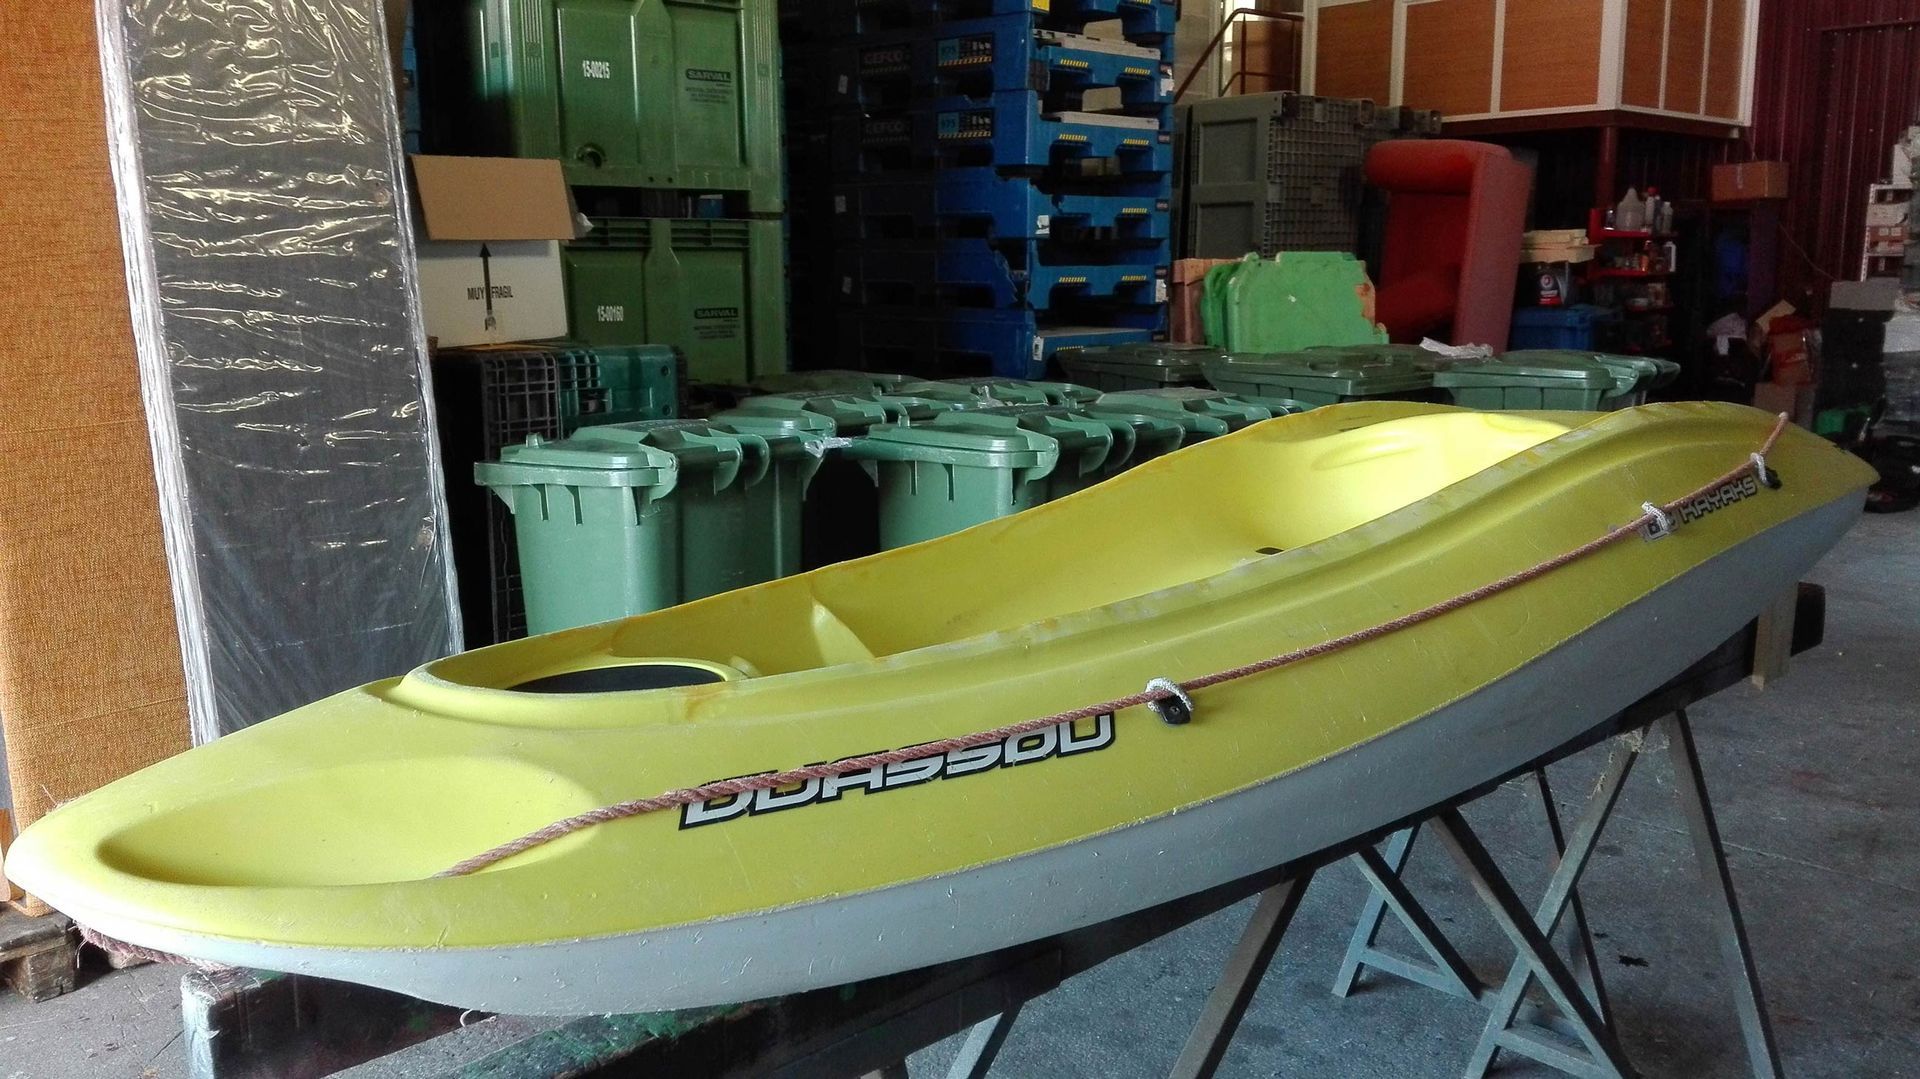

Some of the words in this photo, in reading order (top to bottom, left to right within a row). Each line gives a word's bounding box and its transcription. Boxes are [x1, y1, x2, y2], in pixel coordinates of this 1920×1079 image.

[582, 60, 610, 79] 15-00215
[687, 70, 730, 81] SARVAL
[467, 287, 485, 300] MUY
[696, 308, 737, 318] SARVAL
[1680, 475, 1757, 523] KAYAKS
